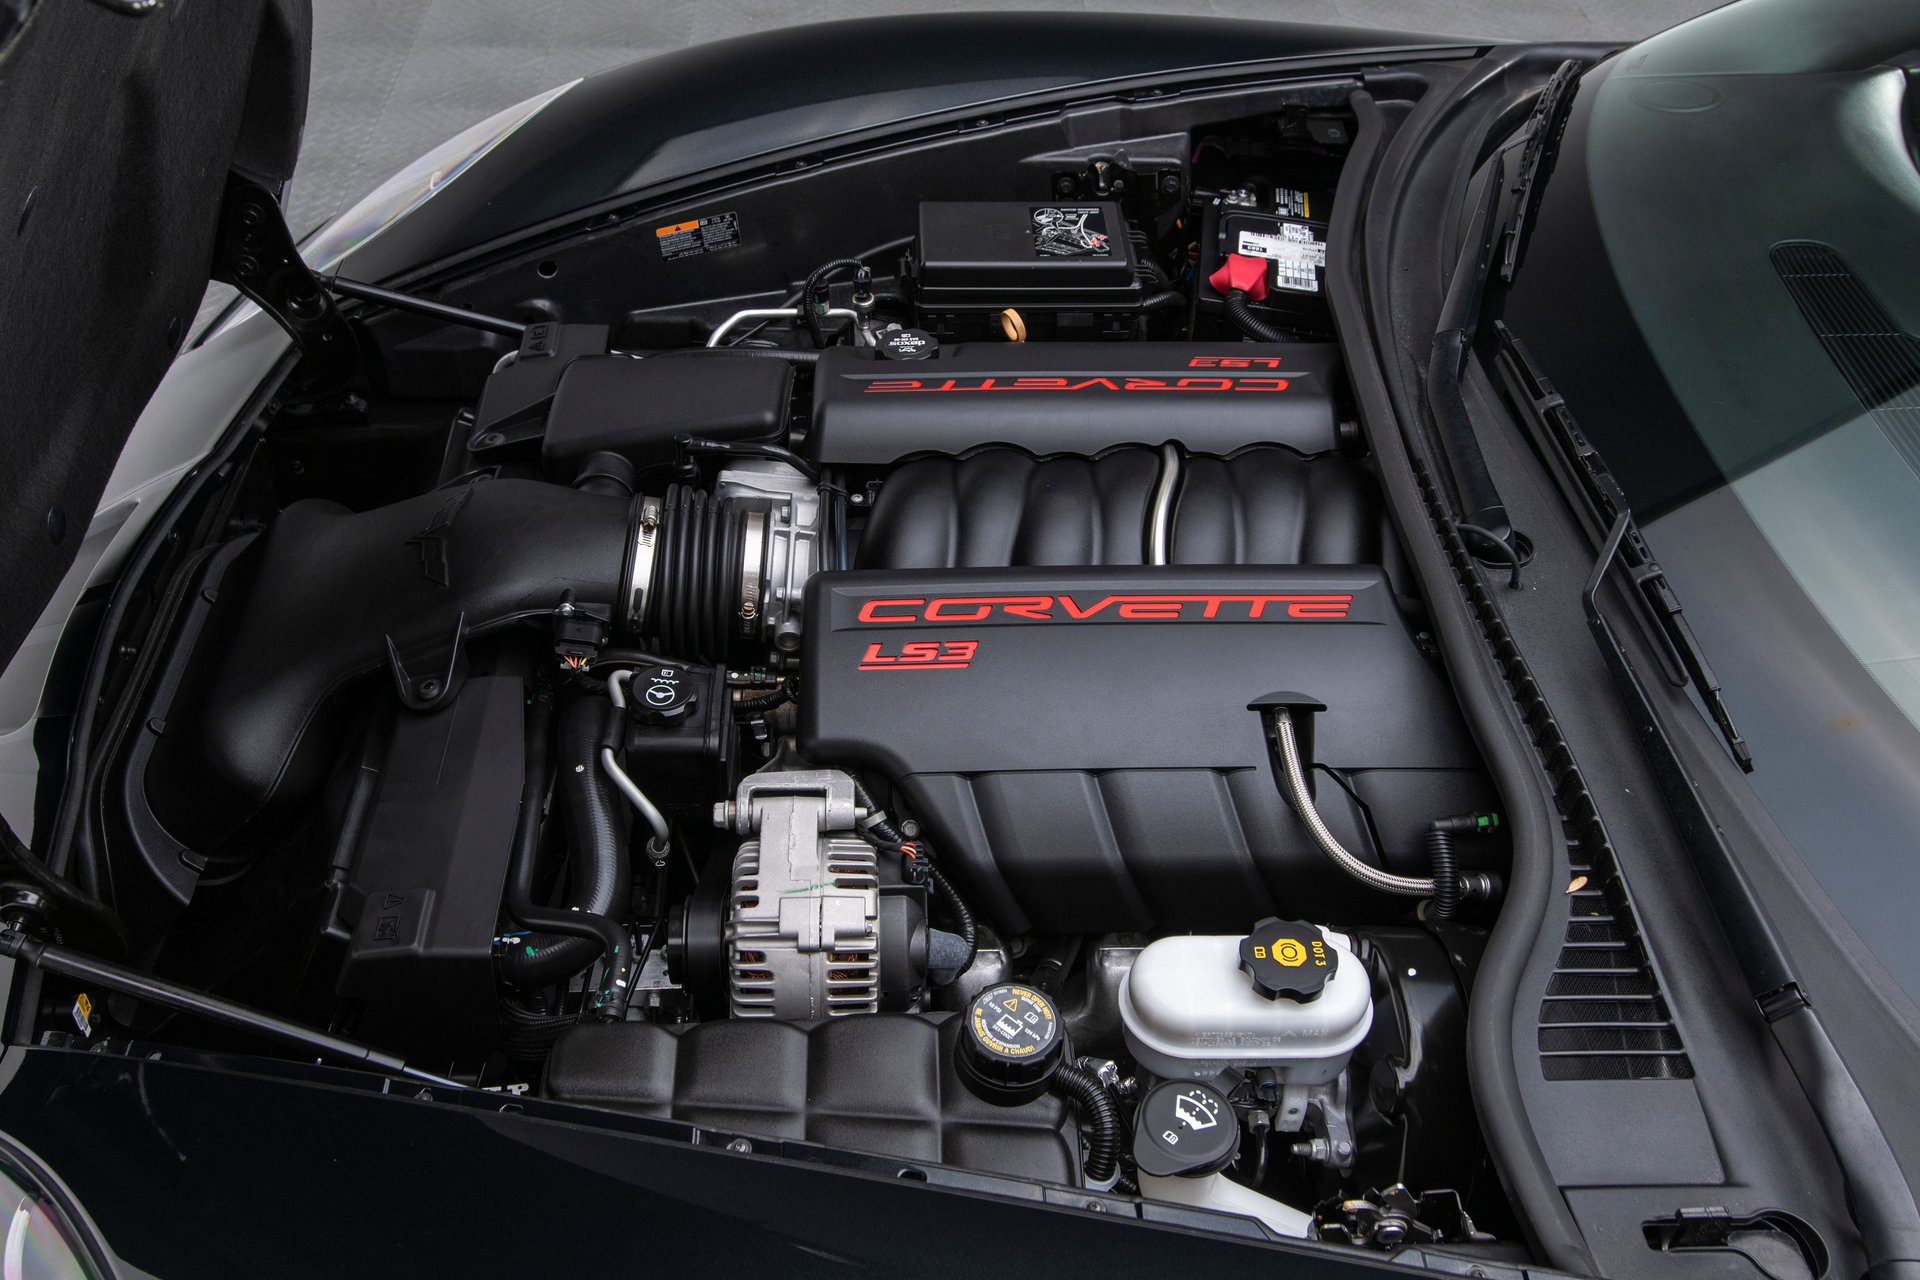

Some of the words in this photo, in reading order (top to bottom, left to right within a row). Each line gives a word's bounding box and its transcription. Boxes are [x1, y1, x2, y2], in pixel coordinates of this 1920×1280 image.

[1188, 356, 1282, 368] LS3
[865, 377, 1290, 393] CORVETTE
[857, 594, 1354, 623] CORVETTE
[859, 640, 980, 670] LS3
[1311, 941, 1326, 959] DOT
[1012, 988, 1032, 998] NEVER
[1030, 993, 1046, 1008] OPEN
[993, 1005, 1002, 1013] PSI
[983, 1036, 1003, 1052] OUVRIR
[1010, 1045, 1035, 1055] CHAUD!
